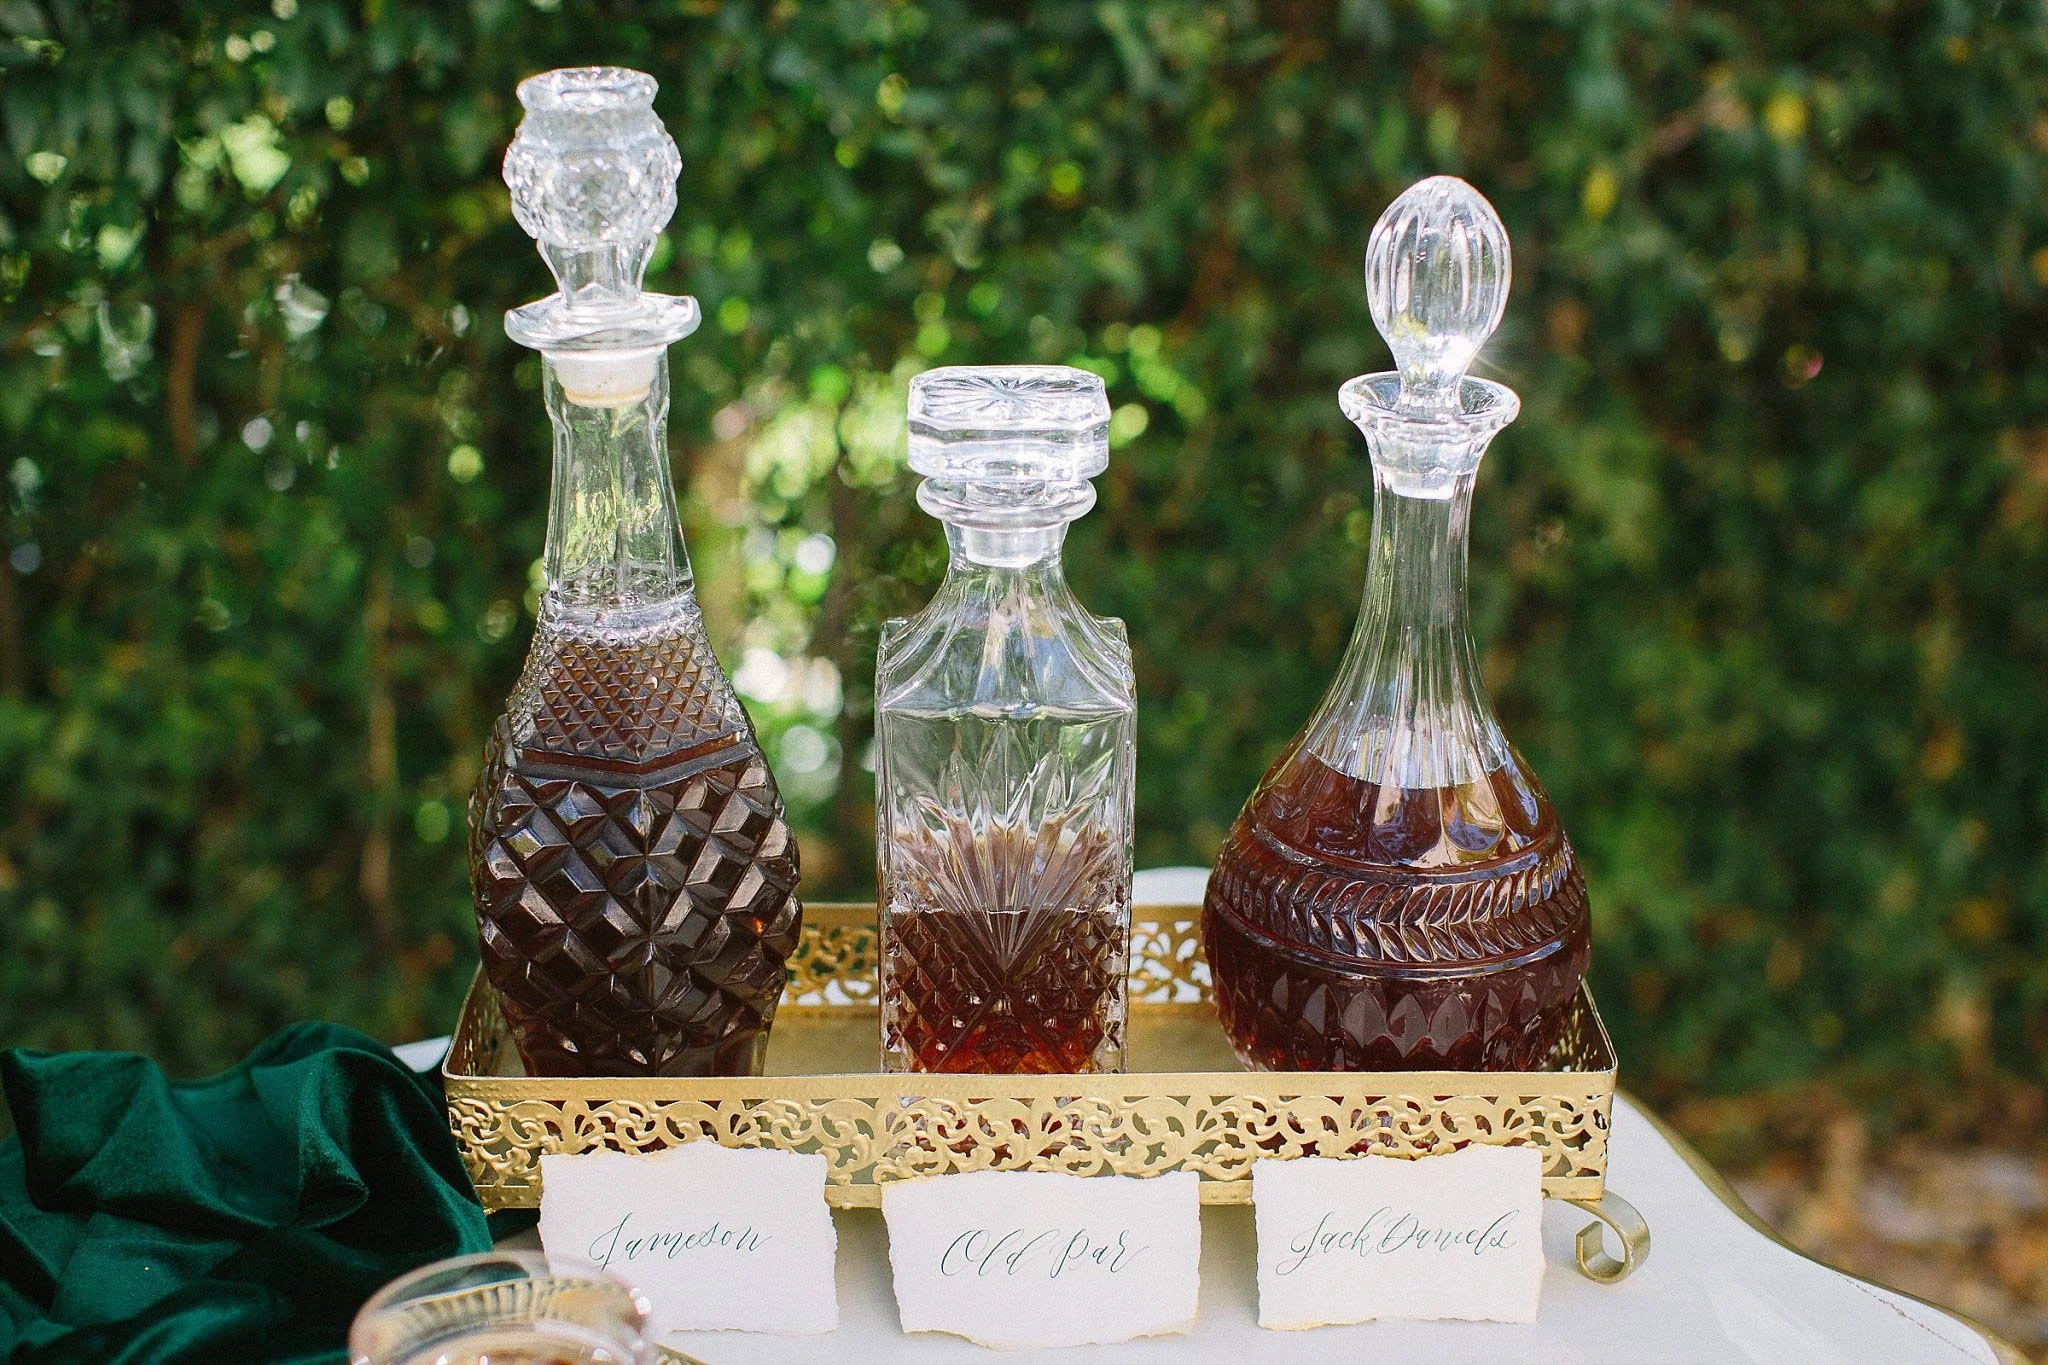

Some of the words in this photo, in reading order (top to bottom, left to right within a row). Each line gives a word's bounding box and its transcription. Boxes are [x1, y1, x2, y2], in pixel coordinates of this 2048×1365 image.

[588, 1211, 773, 1271] Jameson
[941, 1228, 1060, 1276] Old
[1049, 1228, 1150, 1278] Par
[1276, 1206, 1393, 1275] Jack
[1376, 1209, 1520, 1255] Daniels
